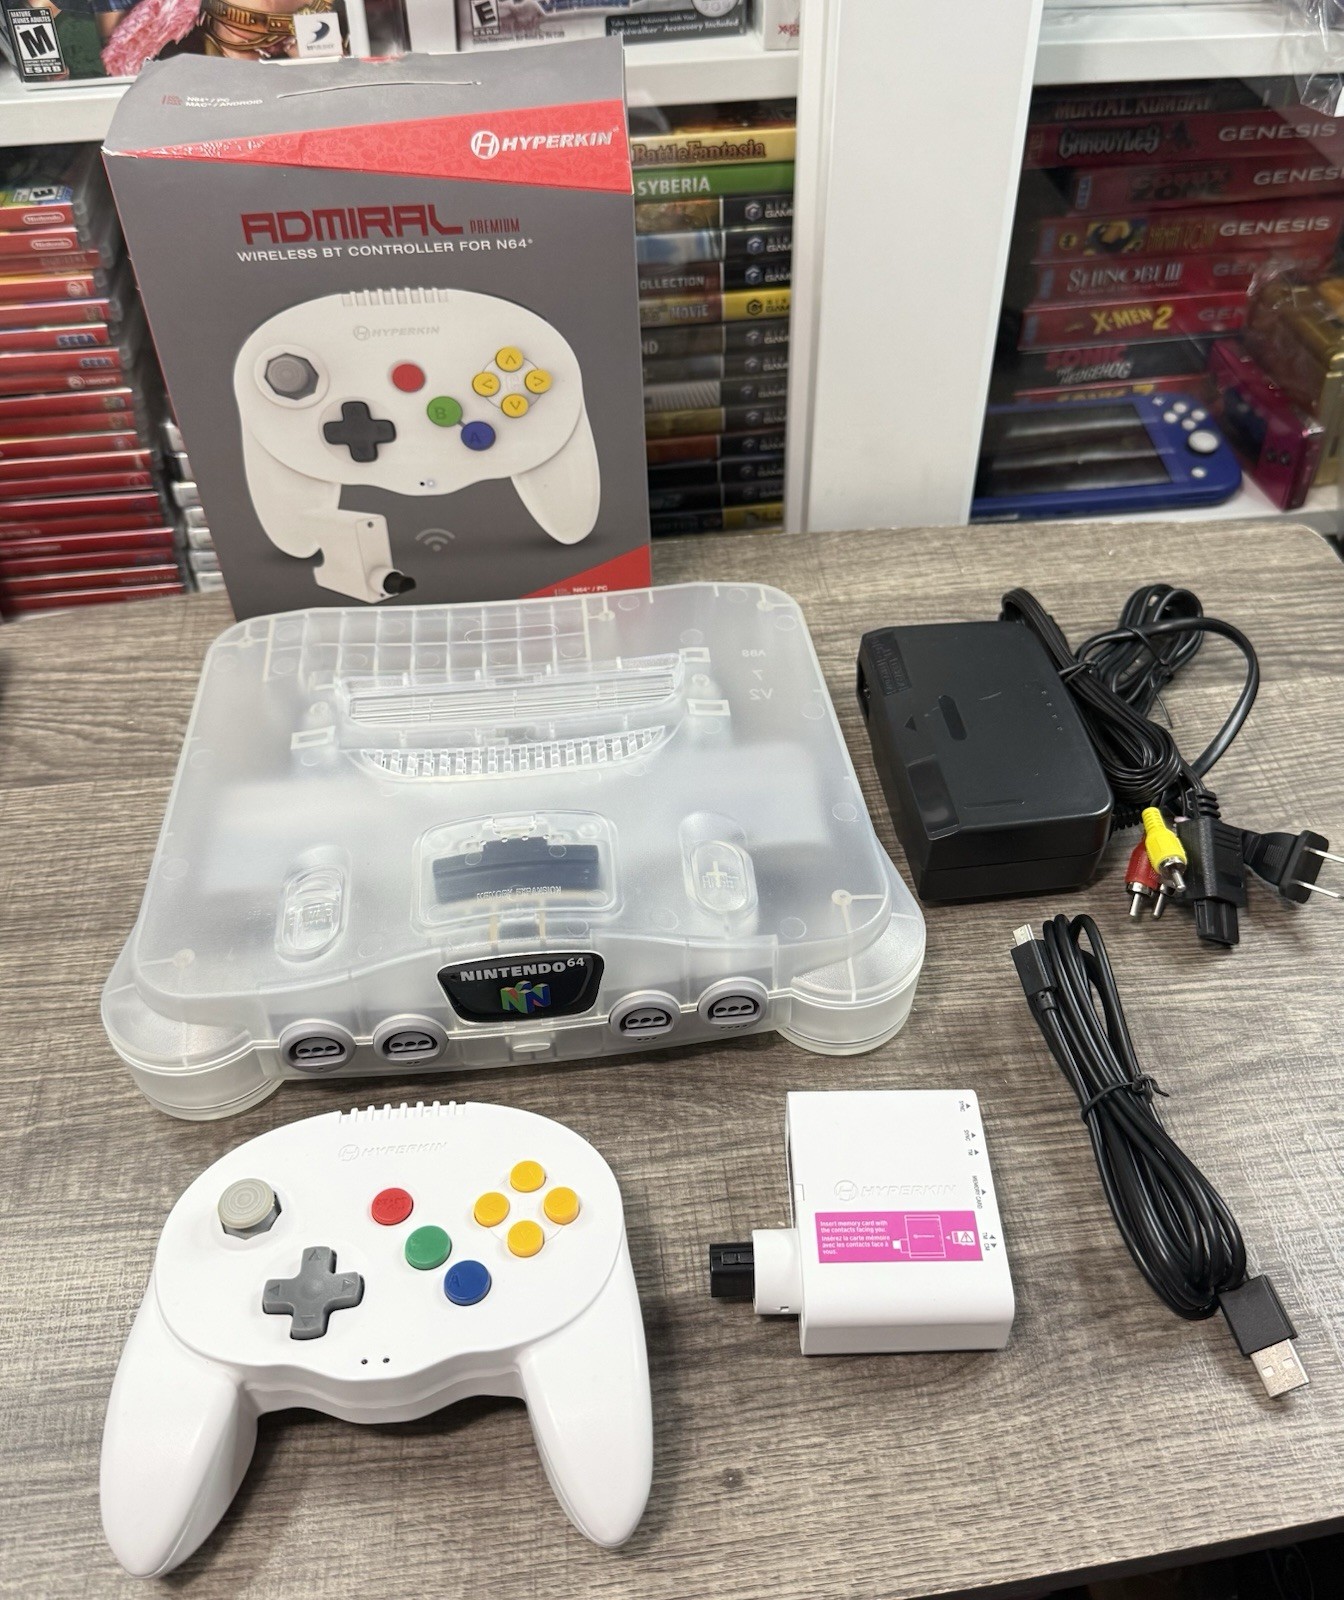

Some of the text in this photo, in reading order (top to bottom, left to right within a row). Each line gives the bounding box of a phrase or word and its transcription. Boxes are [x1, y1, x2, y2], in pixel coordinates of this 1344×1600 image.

[474, 2, 496, 26] E
[705, 18, 739, 29] Included
[19, 25, 55, 58] M
[501, 131, 613, 152] HYPERKIN
[1218, 122, 1337, 141] GENESIS
[637, 176, 711, 196] SYBERIA
[26, 214, 61, 222] Nintendo
[240, 204, 520, 245] ADMIRAL PREMIUM
[1220, 215, 1331, 236] GENESIS
[35, 241, 69, 249] Nintendo
[236, 248, 317, 262] WIRELESS
[322, 247, 342, 258] BT
[348, 242, 453, 257] CONTROLLER
[459, 240, 491, 251] FOR
[640, 276, 705, 290] OLLECTION
[1066, 264, 1162, 292] SHINOBI
[1152, 304, 1174, 331] 2
[372, 326, 440, 337] HYPERKIN
[434, 407, 447, 420] B
[476, 885, 562, 900] MEMORY EXPANSION
[460, 957, 585, 982] NINTENDO 64
[861, 1184, 957, 1198] HYPERKIN
